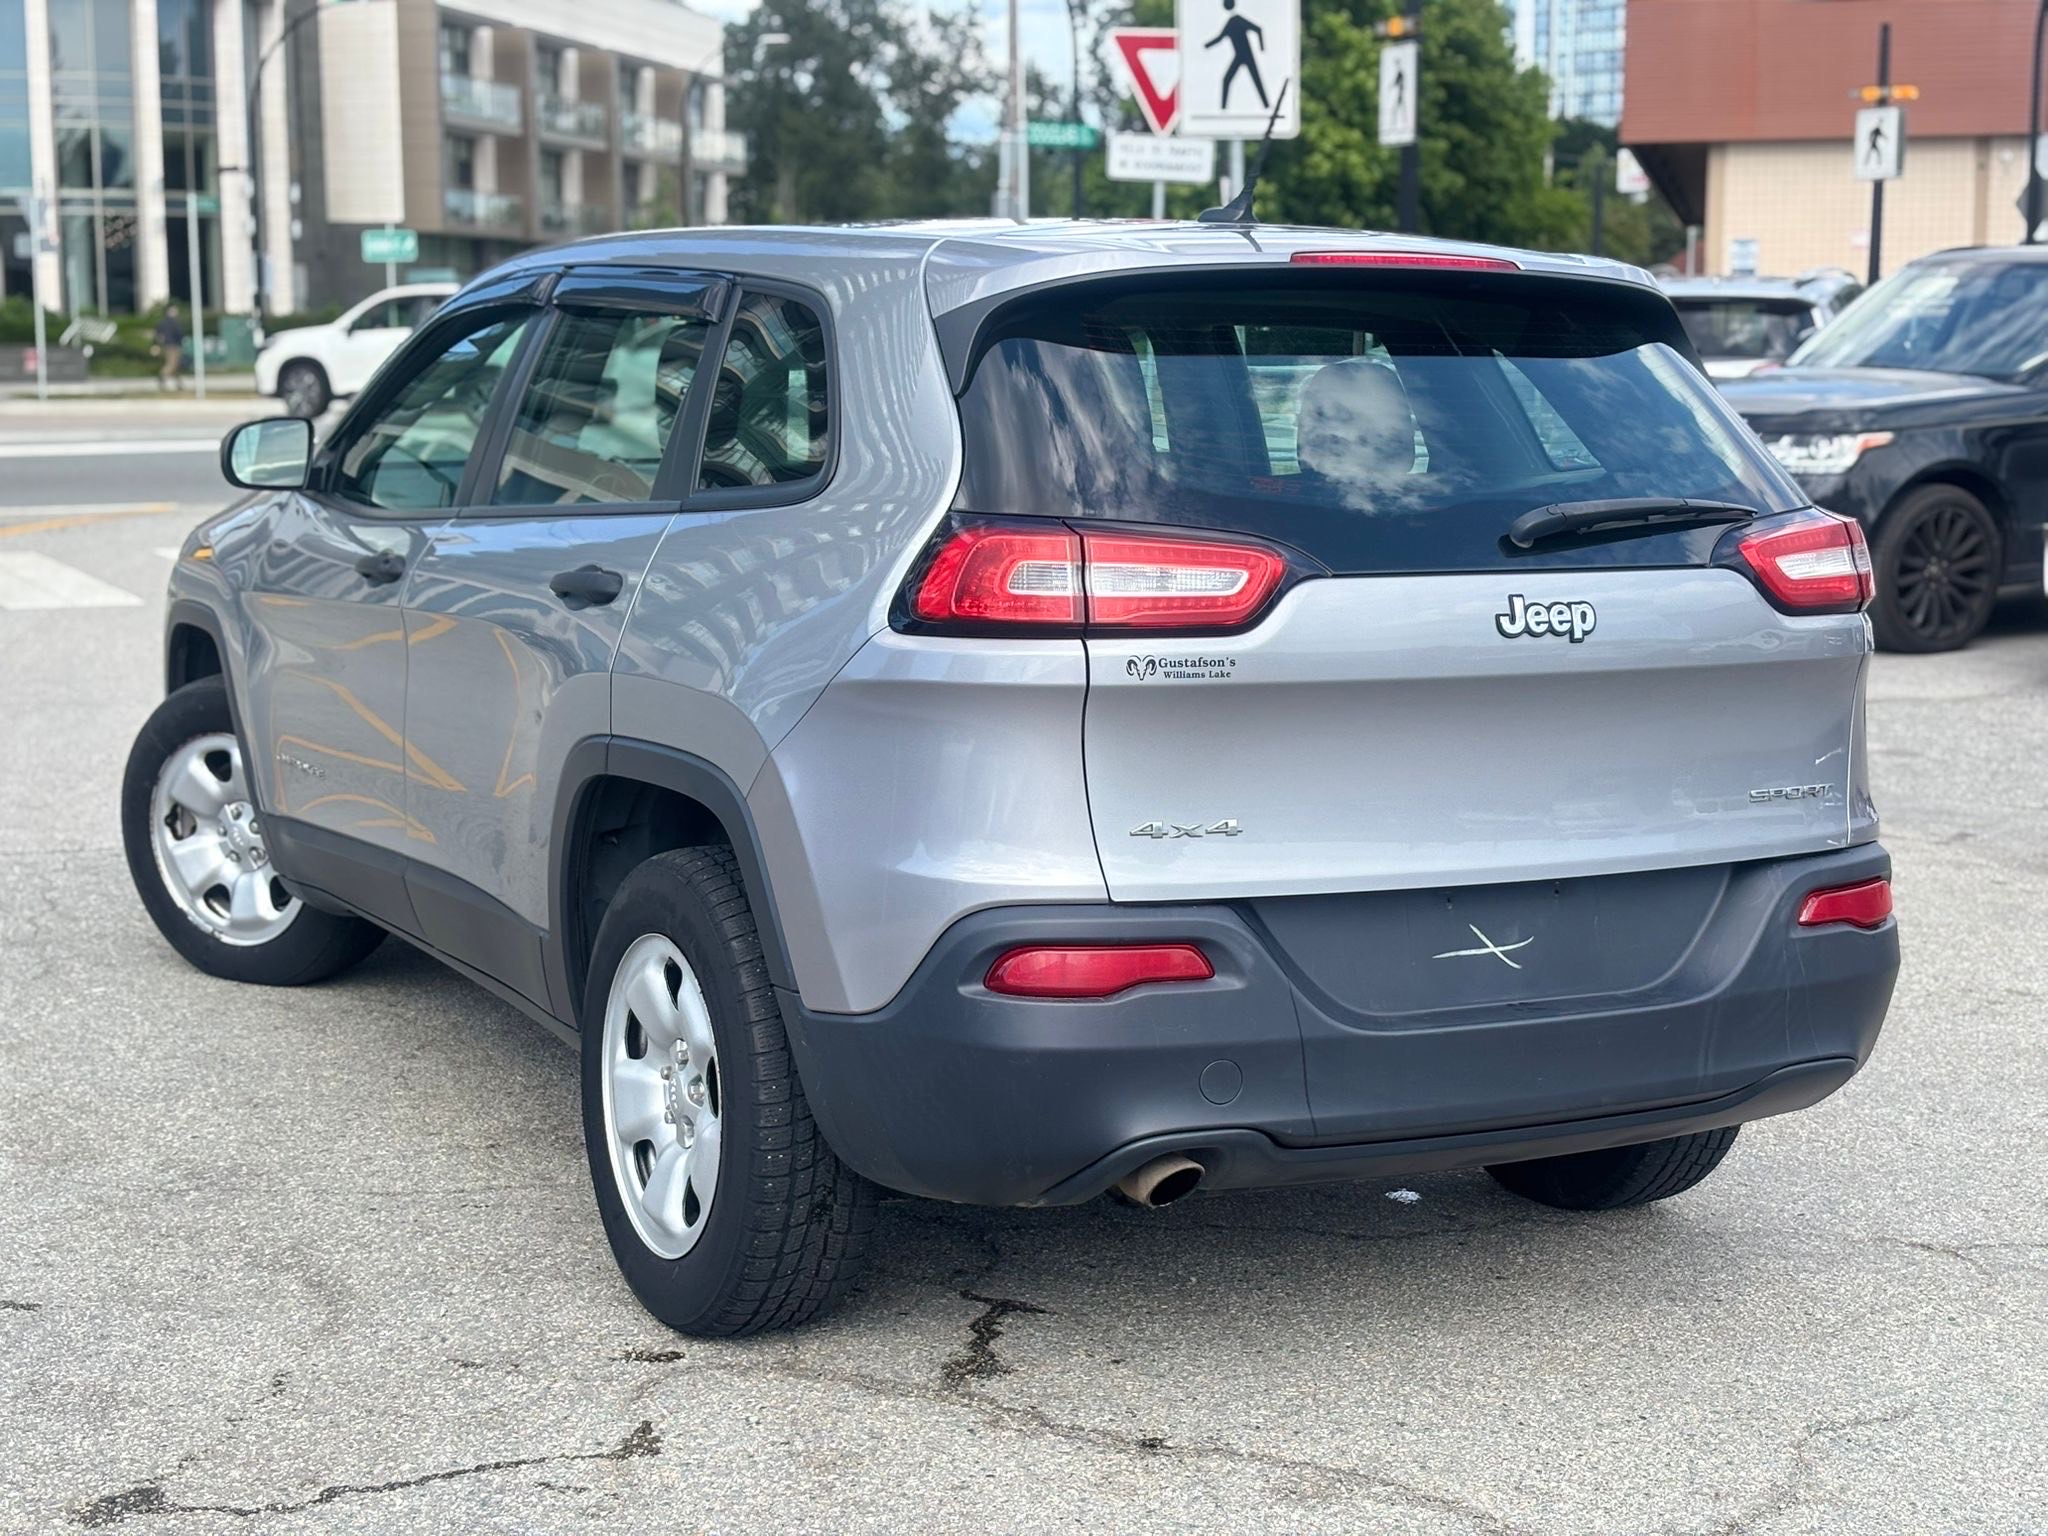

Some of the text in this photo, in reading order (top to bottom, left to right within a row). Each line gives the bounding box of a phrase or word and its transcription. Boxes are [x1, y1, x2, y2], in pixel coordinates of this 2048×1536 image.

[1495, 594, 1597, 643] Jeep
[1158, 657, 1236, 668] Gustafson's
[1163, 670, 1231, 679] Williams Lake
[1748, 783, 1835, 803] SPORT
